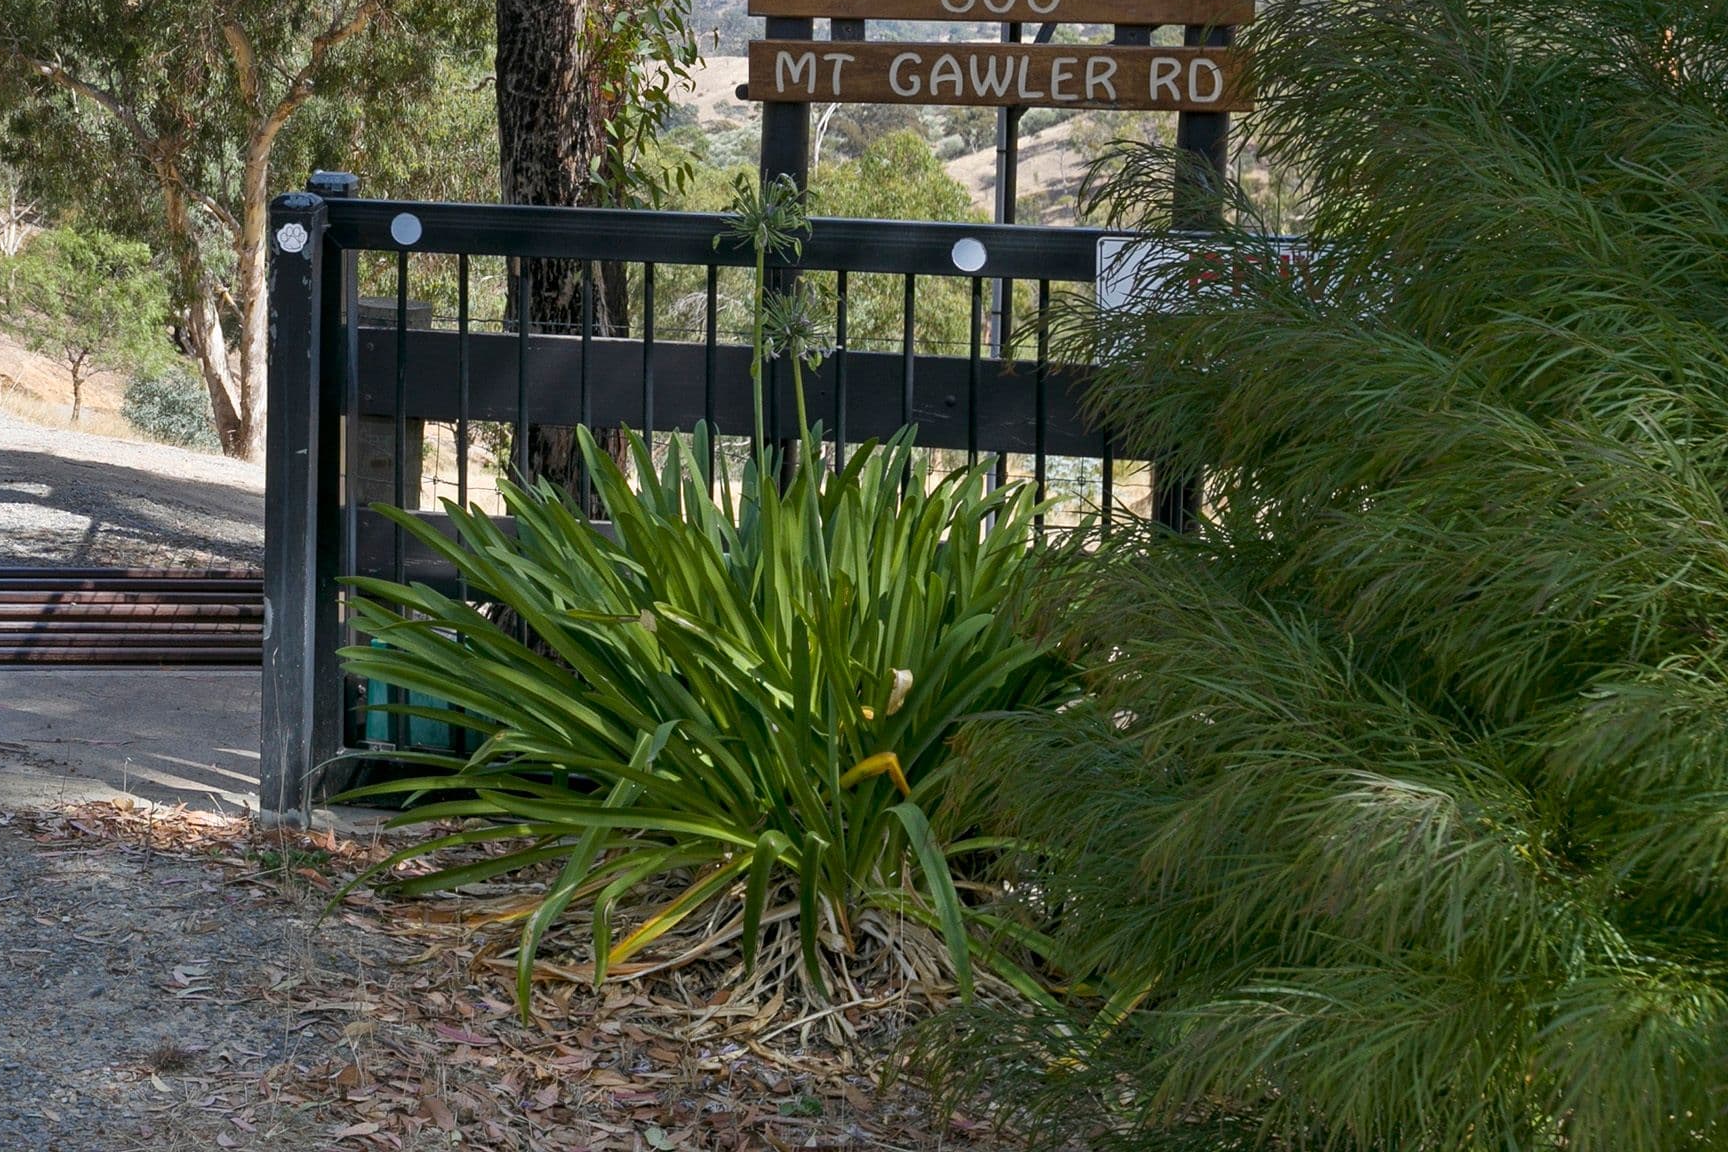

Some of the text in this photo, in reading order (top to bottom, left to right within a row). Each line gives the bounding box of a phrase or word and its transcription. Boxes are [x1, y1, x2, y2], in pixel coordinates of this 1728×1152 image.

[774, 50, 1224, 104] MT GAWLER RD
